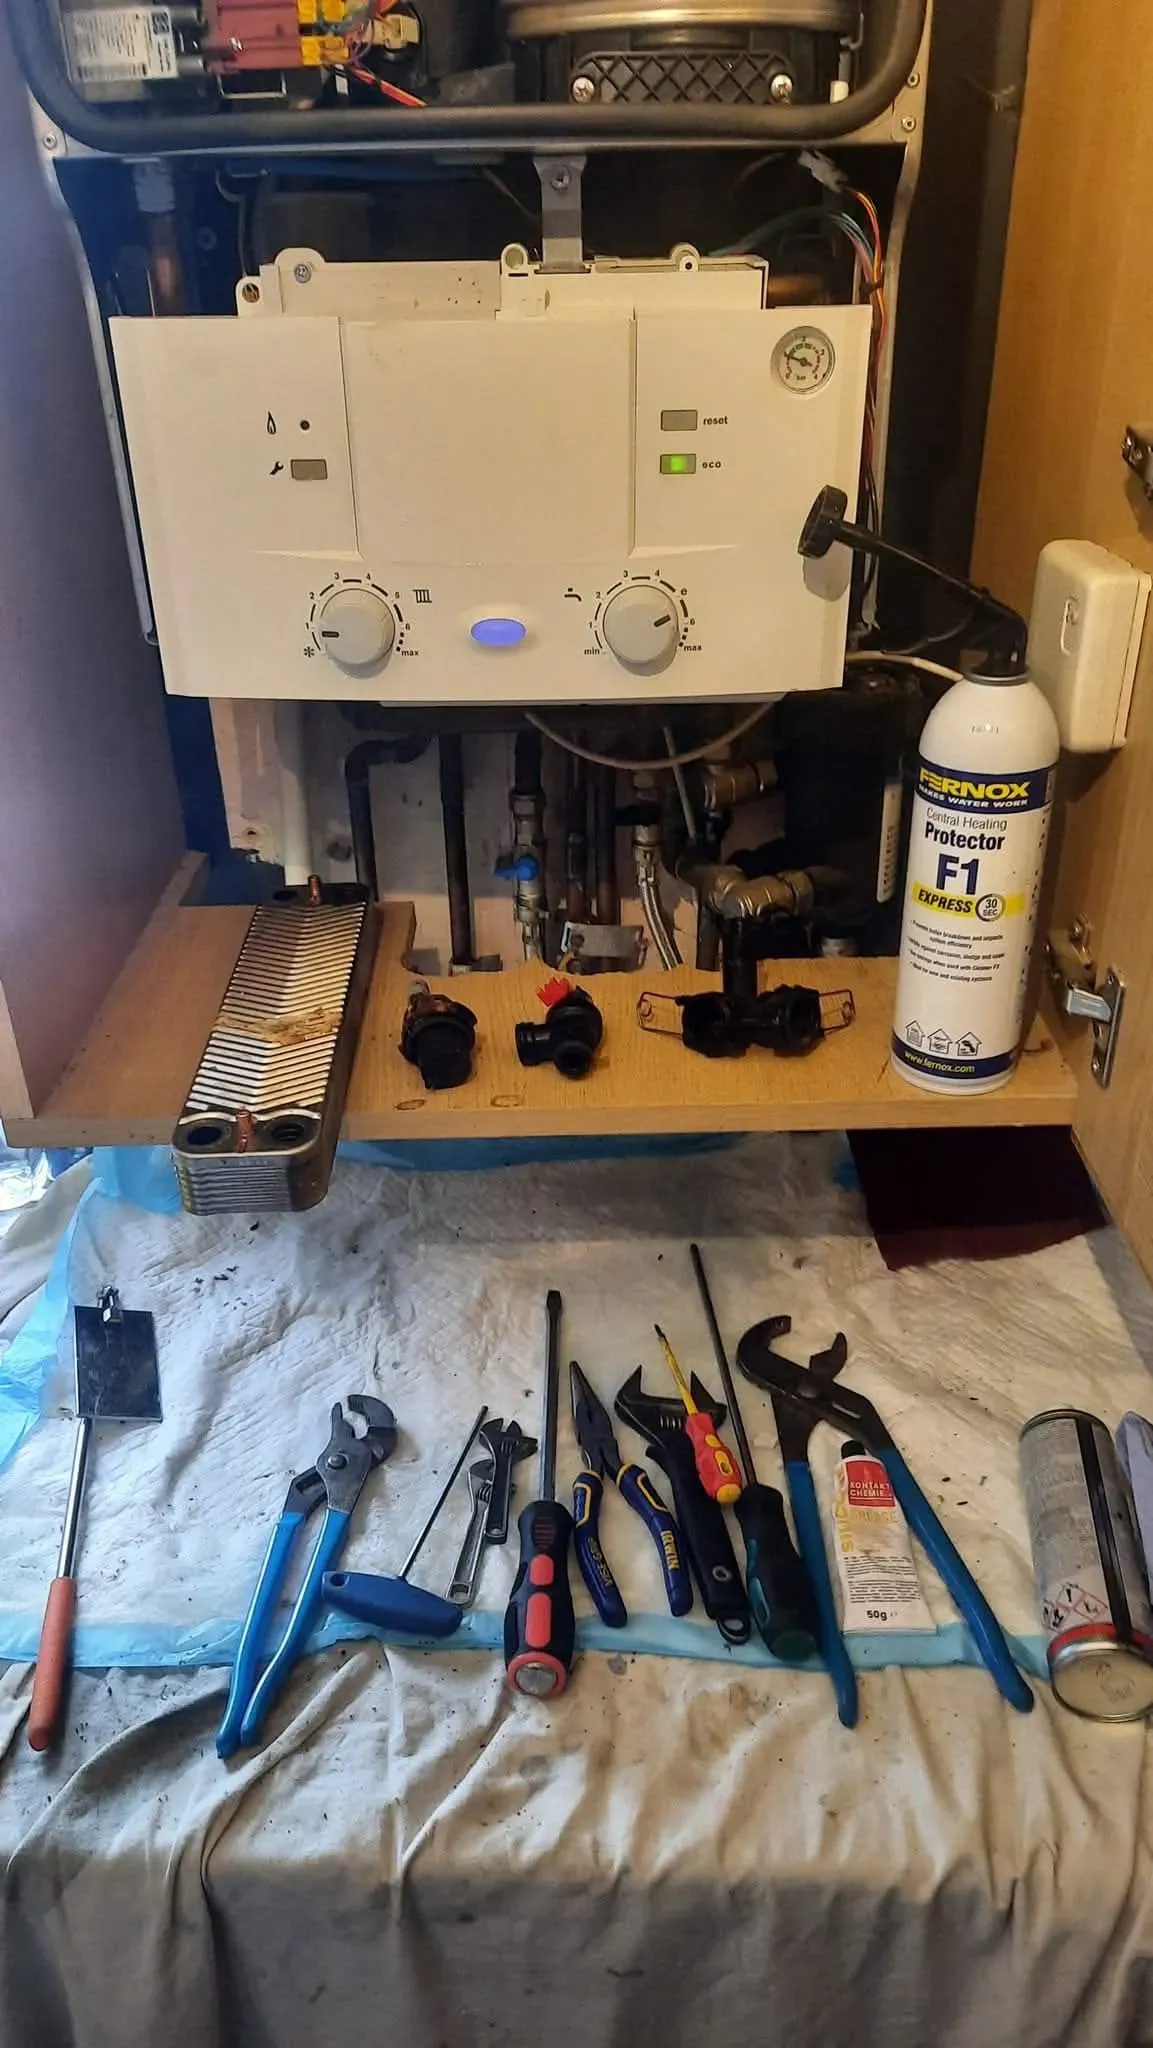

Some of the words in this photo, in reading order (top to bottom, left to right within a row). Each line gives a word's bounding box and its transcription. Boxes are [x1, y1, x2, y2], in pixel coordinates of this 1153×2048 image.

[703, 415, 728, 426] reset
[702, 461, 721, 469] eco
[334, 572, 340, 580] 3
[366, 573, 371, 581] 4
[623, 570, 628, 578] 3
[309, 592, 315, 600] 2
[680, 588, 688, 596] e
[305, 622, 310, 630] 1
[589, 621, 593, 629] 1
[690, 618, 696, 626] 6
[405, 623, 411, 631] 6
[584, 647, 600, 655] min
[919, 767, 1031, 799] FERNOX
[918, 783, 945, 801] MAKES
[950, 795, 989, 808] WATER
[993, 800, 1028, 808] WORK
[926, 807, 959, 827] Central
[963, 817, 1007, 831] Heating
[925, 821, 1005, 850] Protector
[936, 853, 980, 896] F1
[918, 889, 973, 913] EXPRESS
[985, 899, 998, 909] 30
[983, 909, 998, 917] SEC
[850, 1489, 884, 1497] CHEMIE
[660, 1530, 680, 1570] IRWIN
[866, 1610, 887, 1621] 50g
